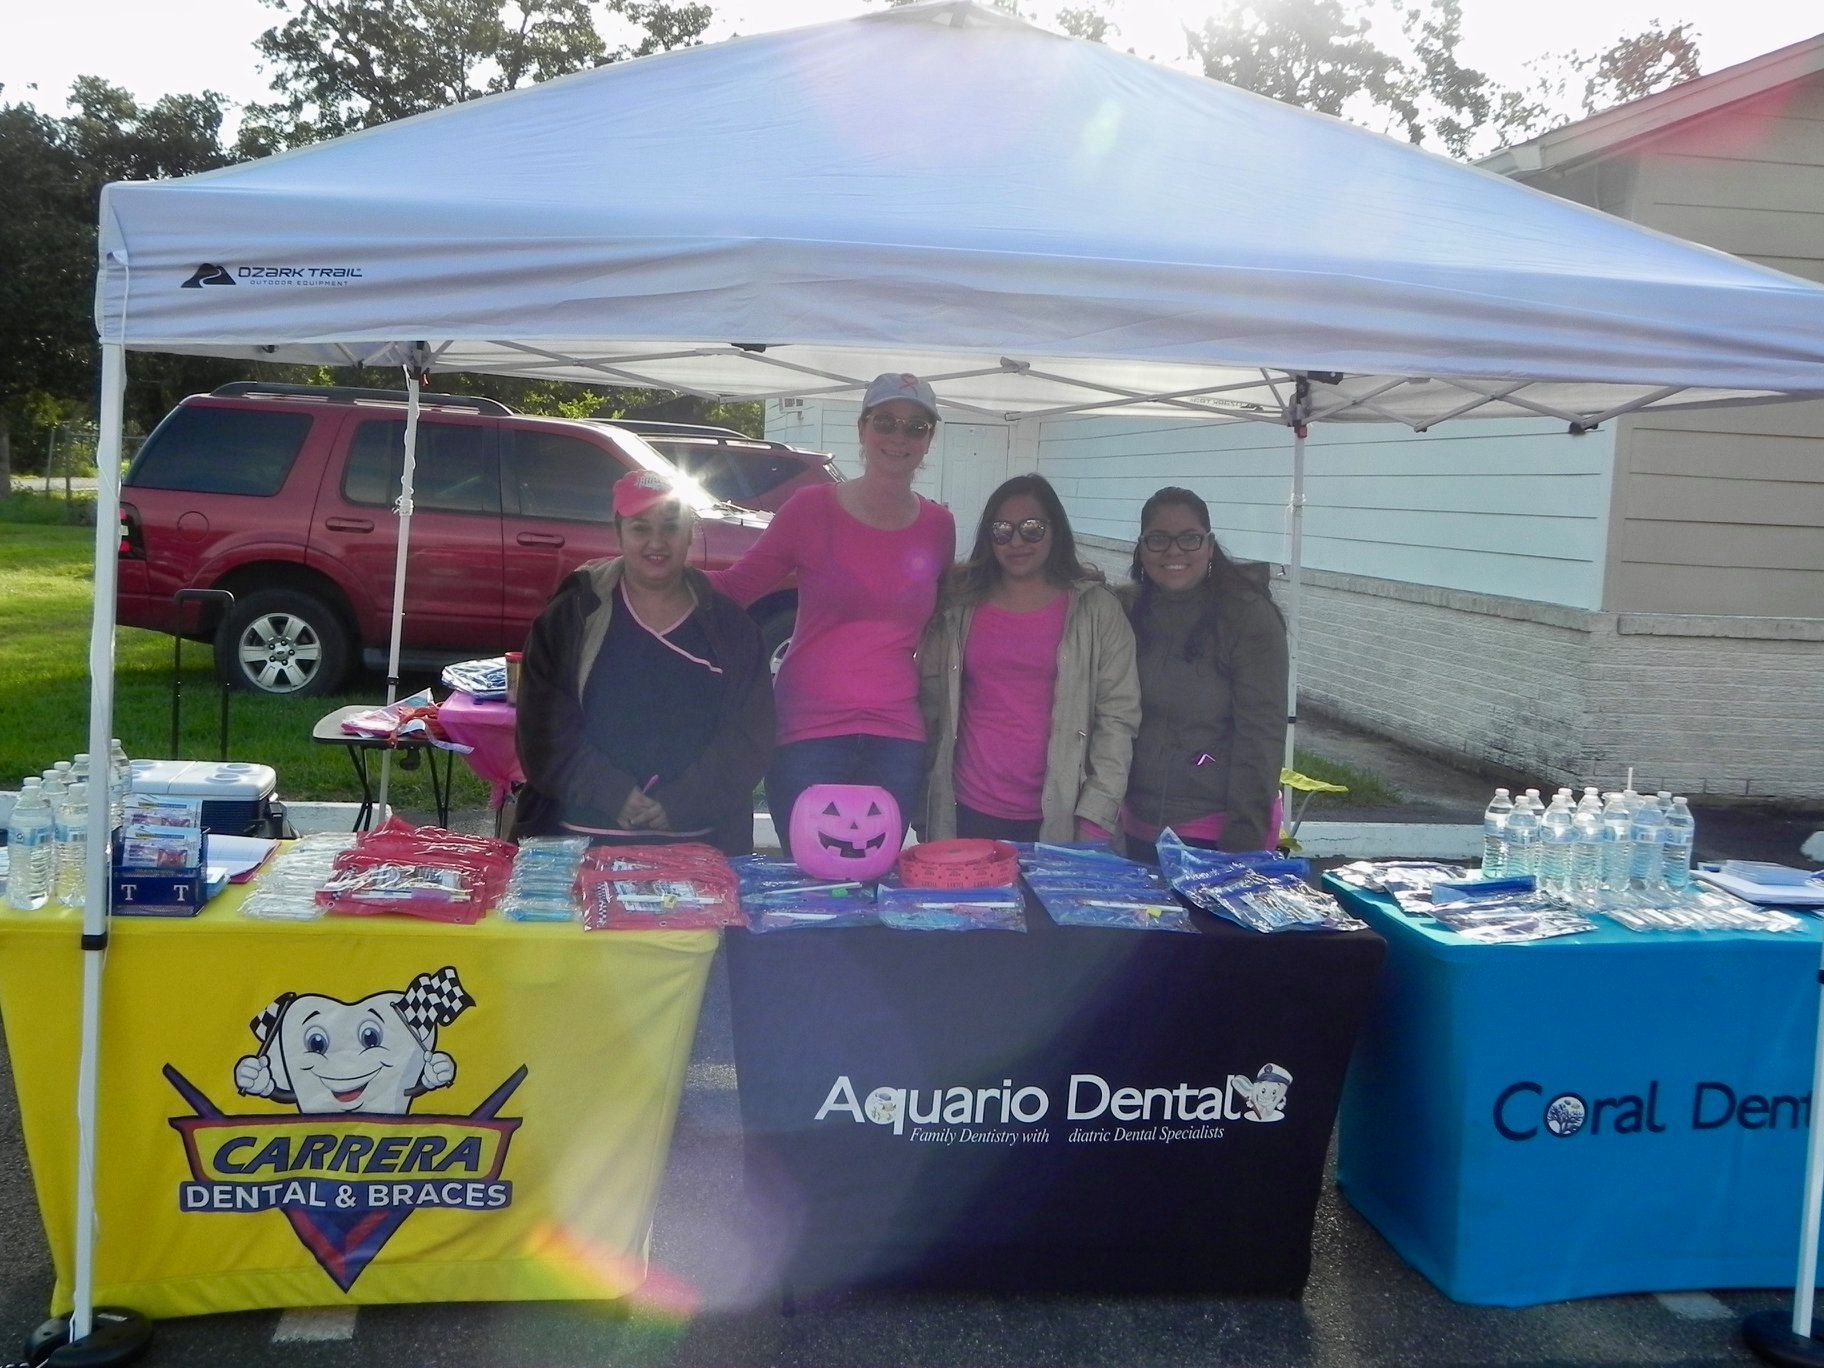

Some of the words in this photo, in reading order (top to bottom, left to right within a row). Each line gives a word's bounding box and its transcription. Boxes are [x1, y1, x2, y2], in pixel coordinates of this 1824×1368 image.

[121, 884, 137, 901] T
[173, 884, 189, 901] T
[814, 1075, 1050, 1136] Aquario
[1066, 1074, 1241, 1122] Dental
[1492, 1080, 1667, 1142] Coral
[910, 1127, 957, 1147] Family
[959, 1127, 1019, 1147] Dentistry
[1022, 1127, 1050, 1143] with
[1113, 1126, 1157, 1142] Dental
[1159, 1124, 1225, 1144] Specialists
[212, 1134, 483, 1175] CARRERA
[186, 1181, 327, 1209] DENTAL
[334, 1183, 358, 1209] &
[368, 1182, 507, 1207] BRACES
